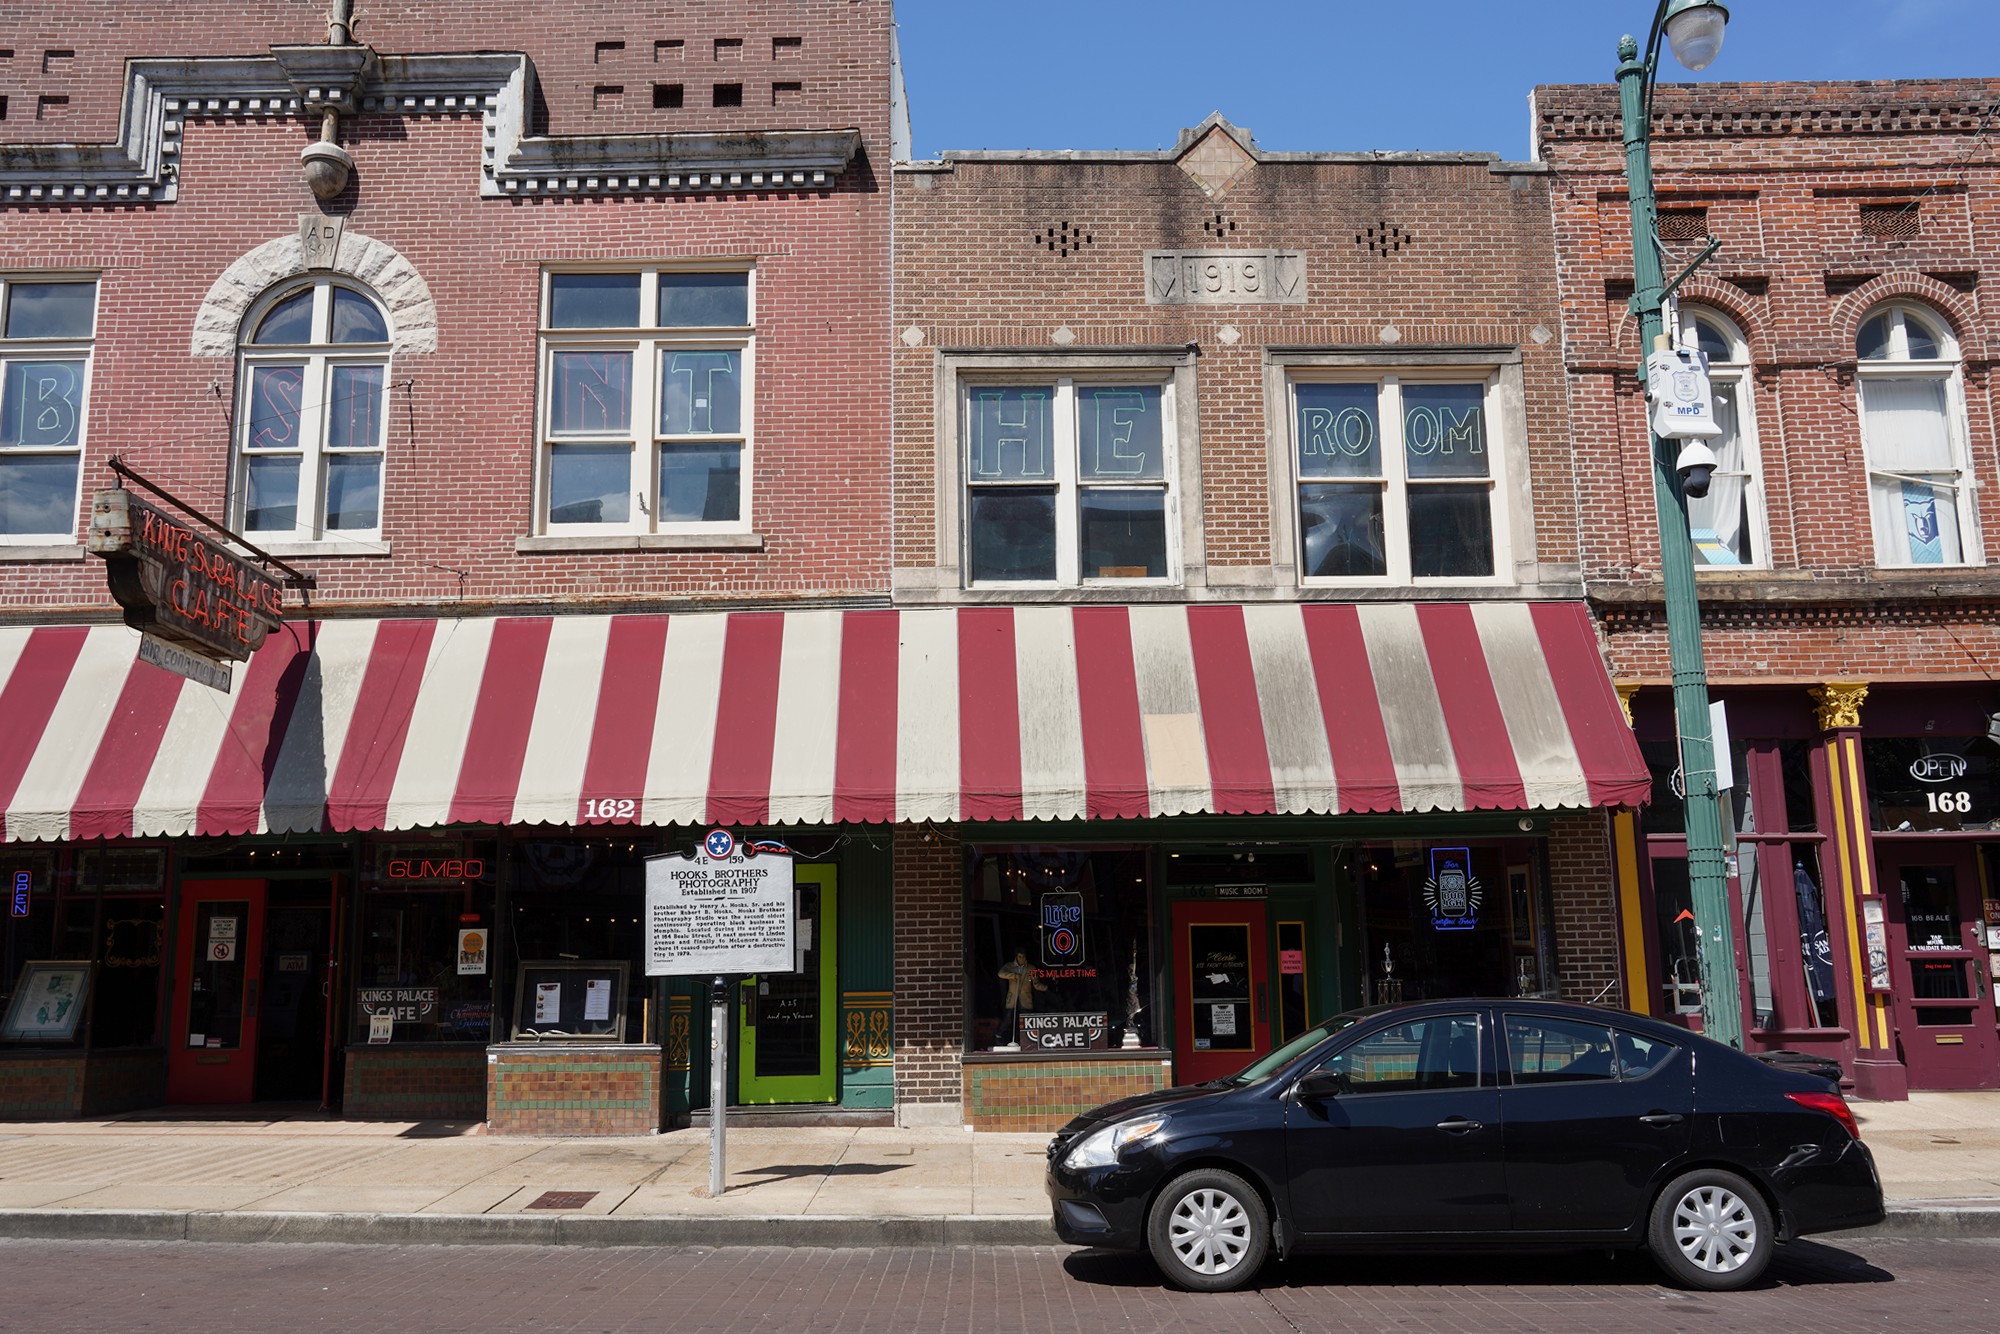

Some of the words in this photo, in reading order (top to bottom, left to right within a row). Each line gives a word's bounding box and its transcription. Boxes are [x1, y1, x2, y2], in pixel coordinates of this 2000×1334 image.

[1188, 261, 1262, 294] 1919
[1677, 406, 1700, 416] MPD
[1301, 405, 1484, 457] ROOM
[213, 554, 283, 615] PALACE
[171, 579, 252, 644] CAFE
[1913, 758, 1964, 776] OPEN
[584, 798, 636, 818] 162
[1926, 790, 1972, 813] 168
[729, 856, 744, 864] 159
[389, 860, 483, 878] GUMBO
[670, 871, 708, 880] HOOKS
[714, 869, 768, 878] BROTHERS
[679, 878, 760, 888] PHOTOGRAPHY
[14, 873, 29, 914] OPEN
[1243, 887, 1263, 895] ROOM
[1044, 904, 1081, 928] Lite
[286, 962, 304, 970] ATM
[1046, 968, 1076, 978] MILLER
[1078, 968, 1097, 978] TIME
[361, 990, 393, 1002] KINGS
[396, 990, 434, 1001] PALACE
[376, 1006, 416, 1020] CAFE
[1024, 1017, 1059, 1029] KINGS
[1063, 1016, 1103, 1028] PALACE
[1041, 1033, 1085, 1048] CAFE
